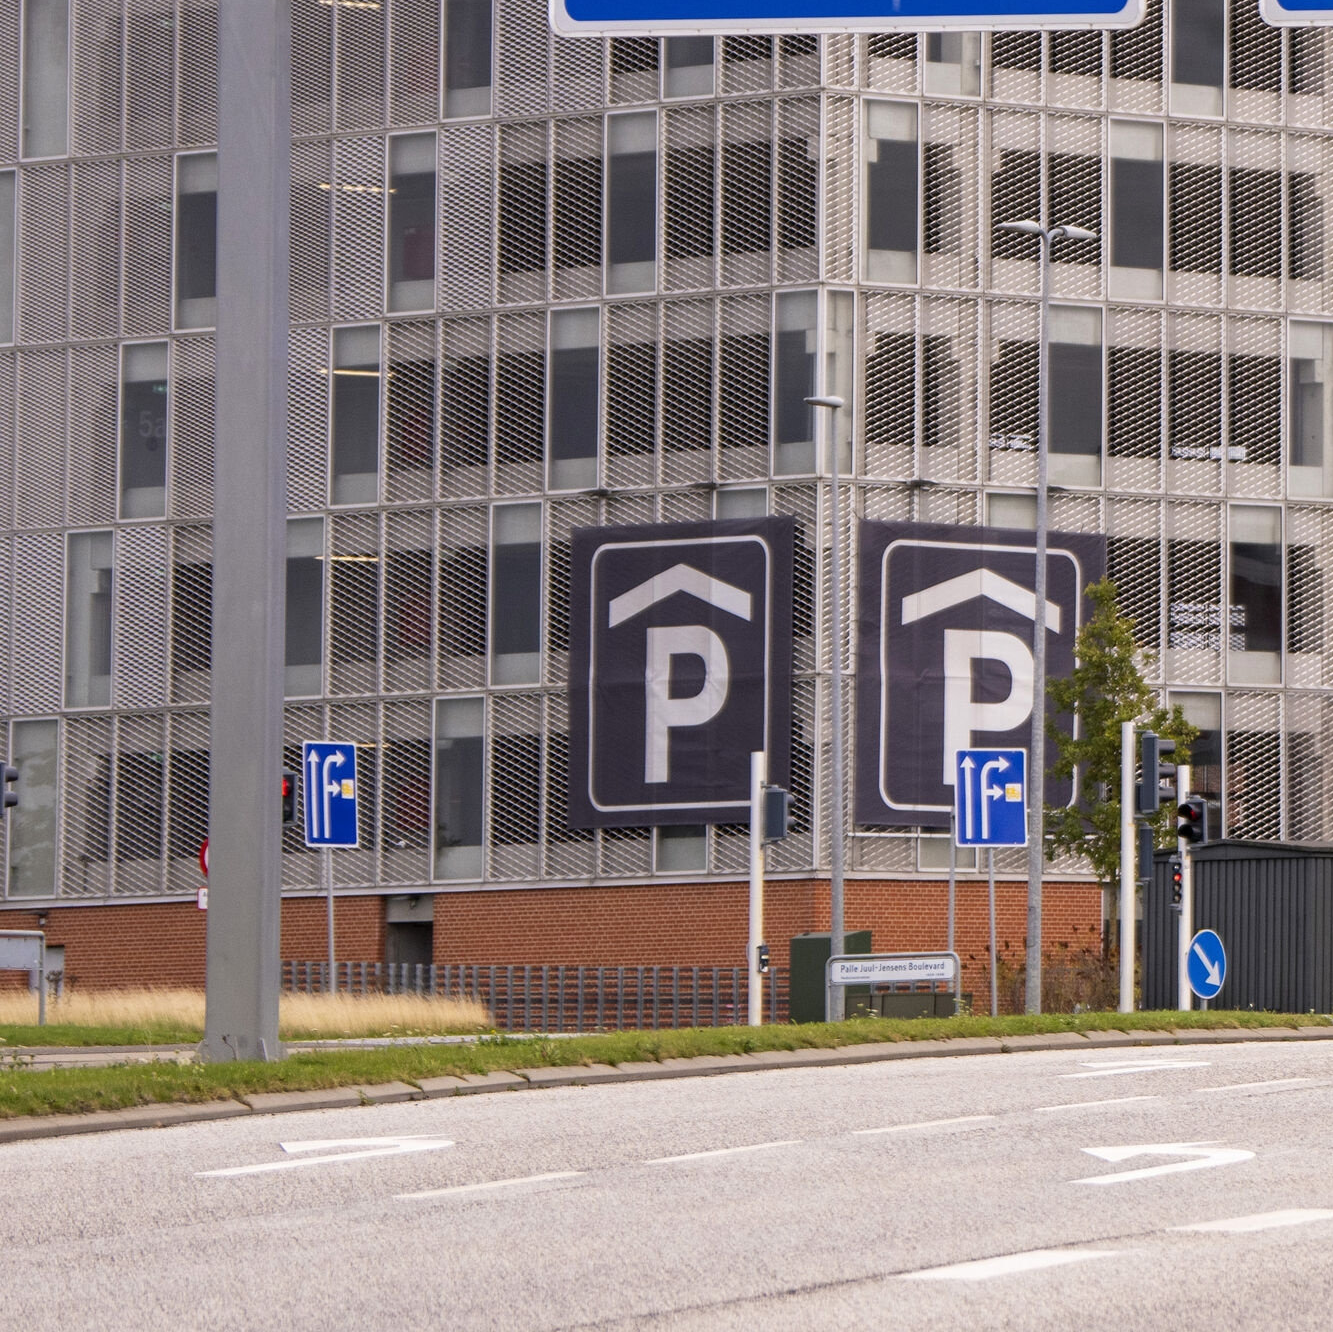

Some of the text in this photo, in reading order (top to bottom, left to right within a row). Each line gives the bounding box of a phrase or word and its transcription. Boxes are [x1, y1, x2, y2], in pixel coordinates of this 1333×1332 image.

[644, 625, 730, 784] P
[943, 629, 1036, 786] P
[840, 961, 945, 973] Palle Juul-Jensens Boulevard
